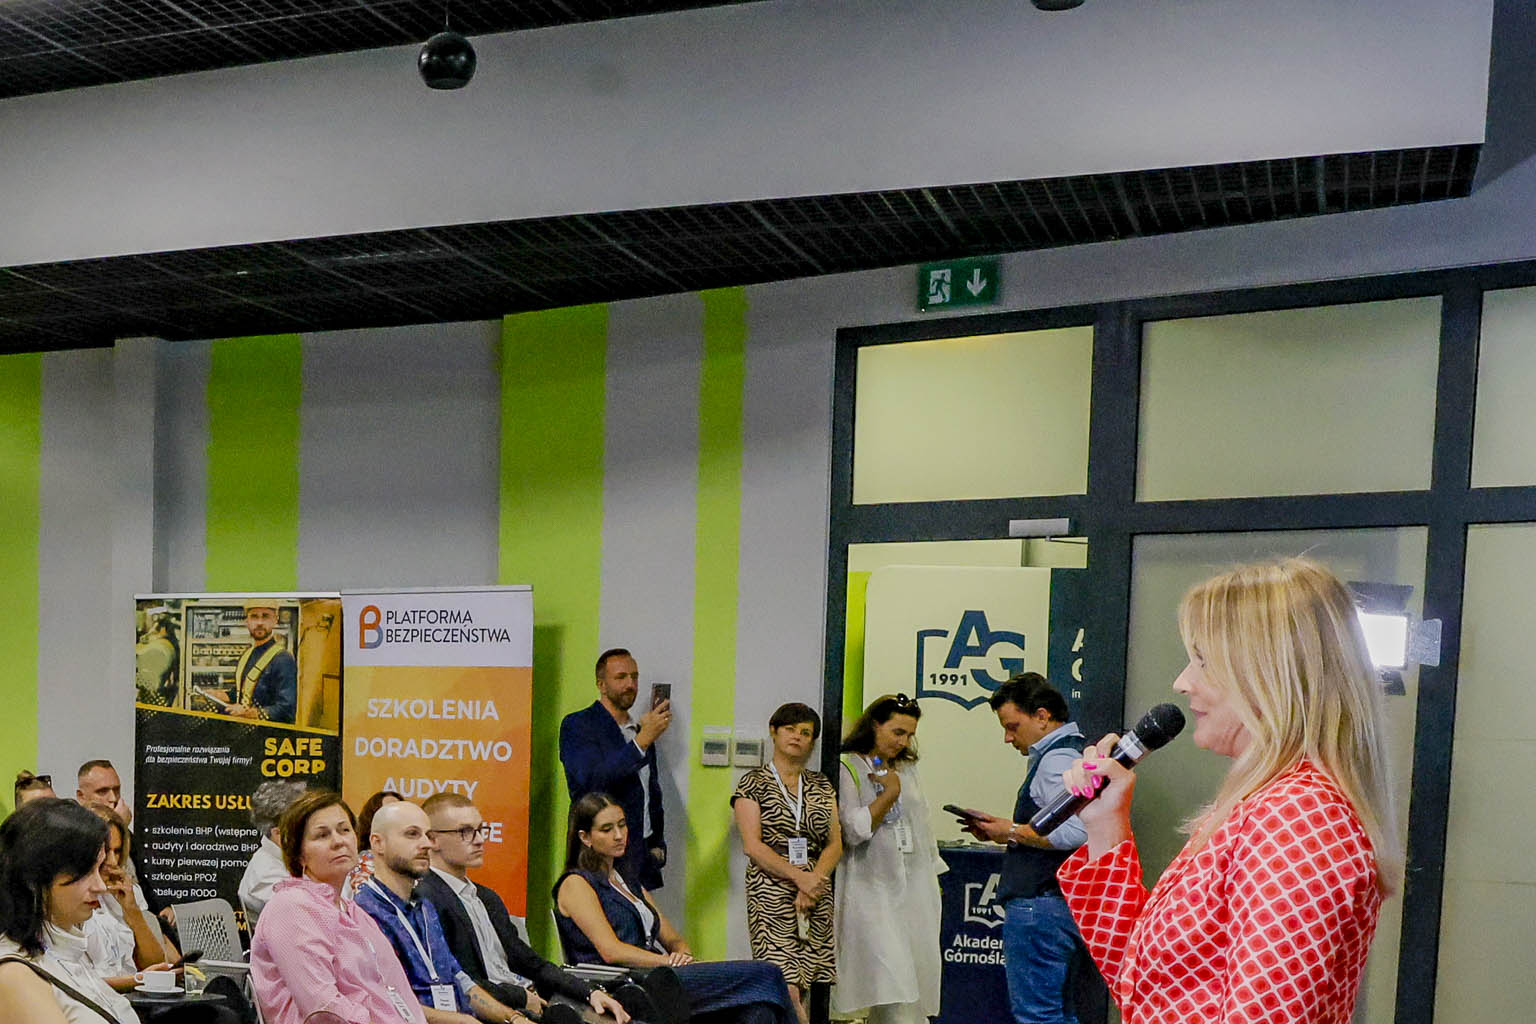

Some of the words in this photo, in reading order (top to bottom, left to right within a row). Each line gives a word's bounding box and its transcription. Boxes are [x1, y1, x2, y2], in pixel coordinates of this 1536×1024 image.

[386, 610, 473, 625] PLATFORMA
[386, 625, 511, 643] BEZPIECZEŃSTWA
[929, 673, 968, 686] 1991
[367, 698, 500, 720] SZKOLENIA
[264, 737, 323, 757] SAFE
[355, 736, 513, 762] DORADZTWO
[260, 758, 326, 778] CORP
[146, 793, 212, 809] ZAKRES
[152, 826, 194, 835] szkolenia
[195, 827, 213, 835] BHP
[215, 825, 258, 838] (wstępne
[152, 843, 183, 852] audyty
[190, 842, 239, 852] doradztwo
[241, 844, 259, 852] BHP
[151, 857, 176, 867] kursy
[177, 857, 219, 868] pierwszej
[151, 872, 193, 881] szkolenia
[190, 889, 217, 898] RODO
[953, 934, 1004, 950] Akade
